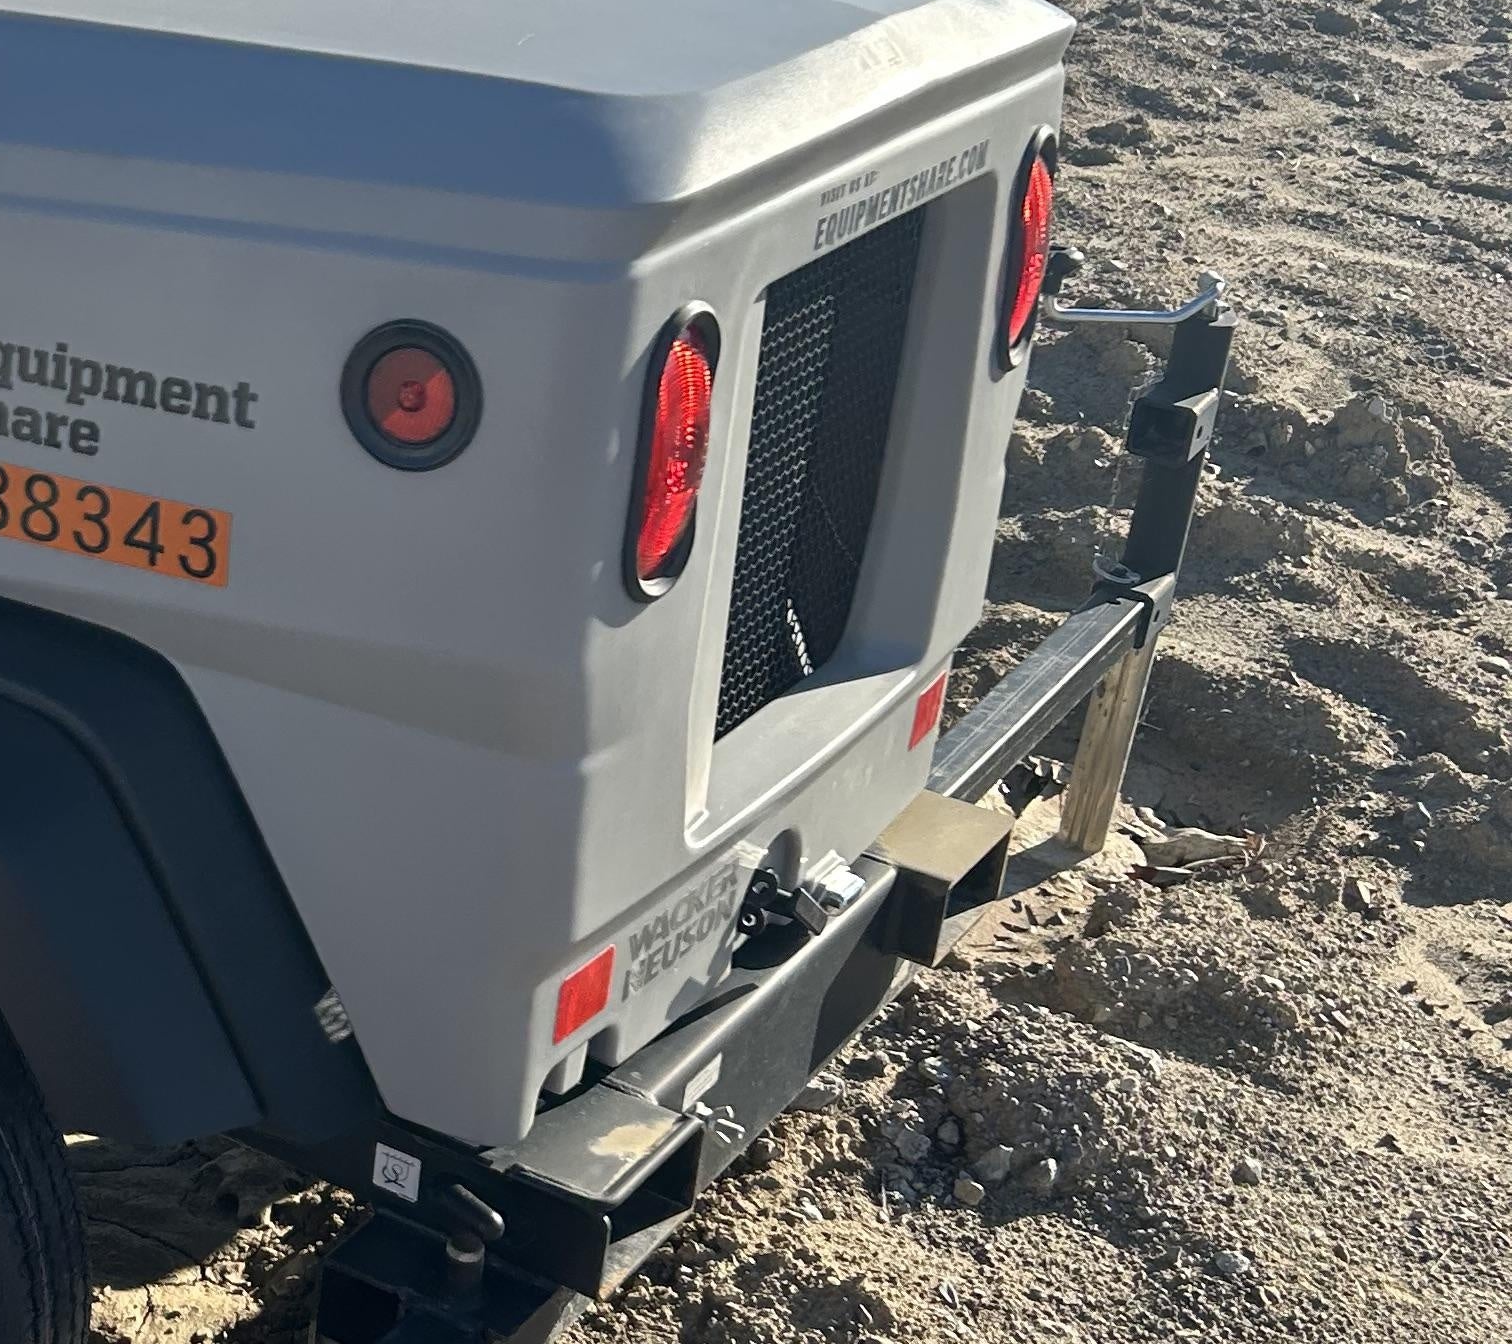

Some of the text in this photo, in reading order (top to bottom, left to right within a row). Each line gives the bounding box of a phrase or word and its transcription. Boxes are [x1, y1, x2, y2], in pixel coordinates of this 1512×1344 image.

[814, 138, 990, 250] EQUIPMENTSHARE.COM
[621, 889, 737, 1002] NEUSON
[629, 863, 738, 962] WACKER
